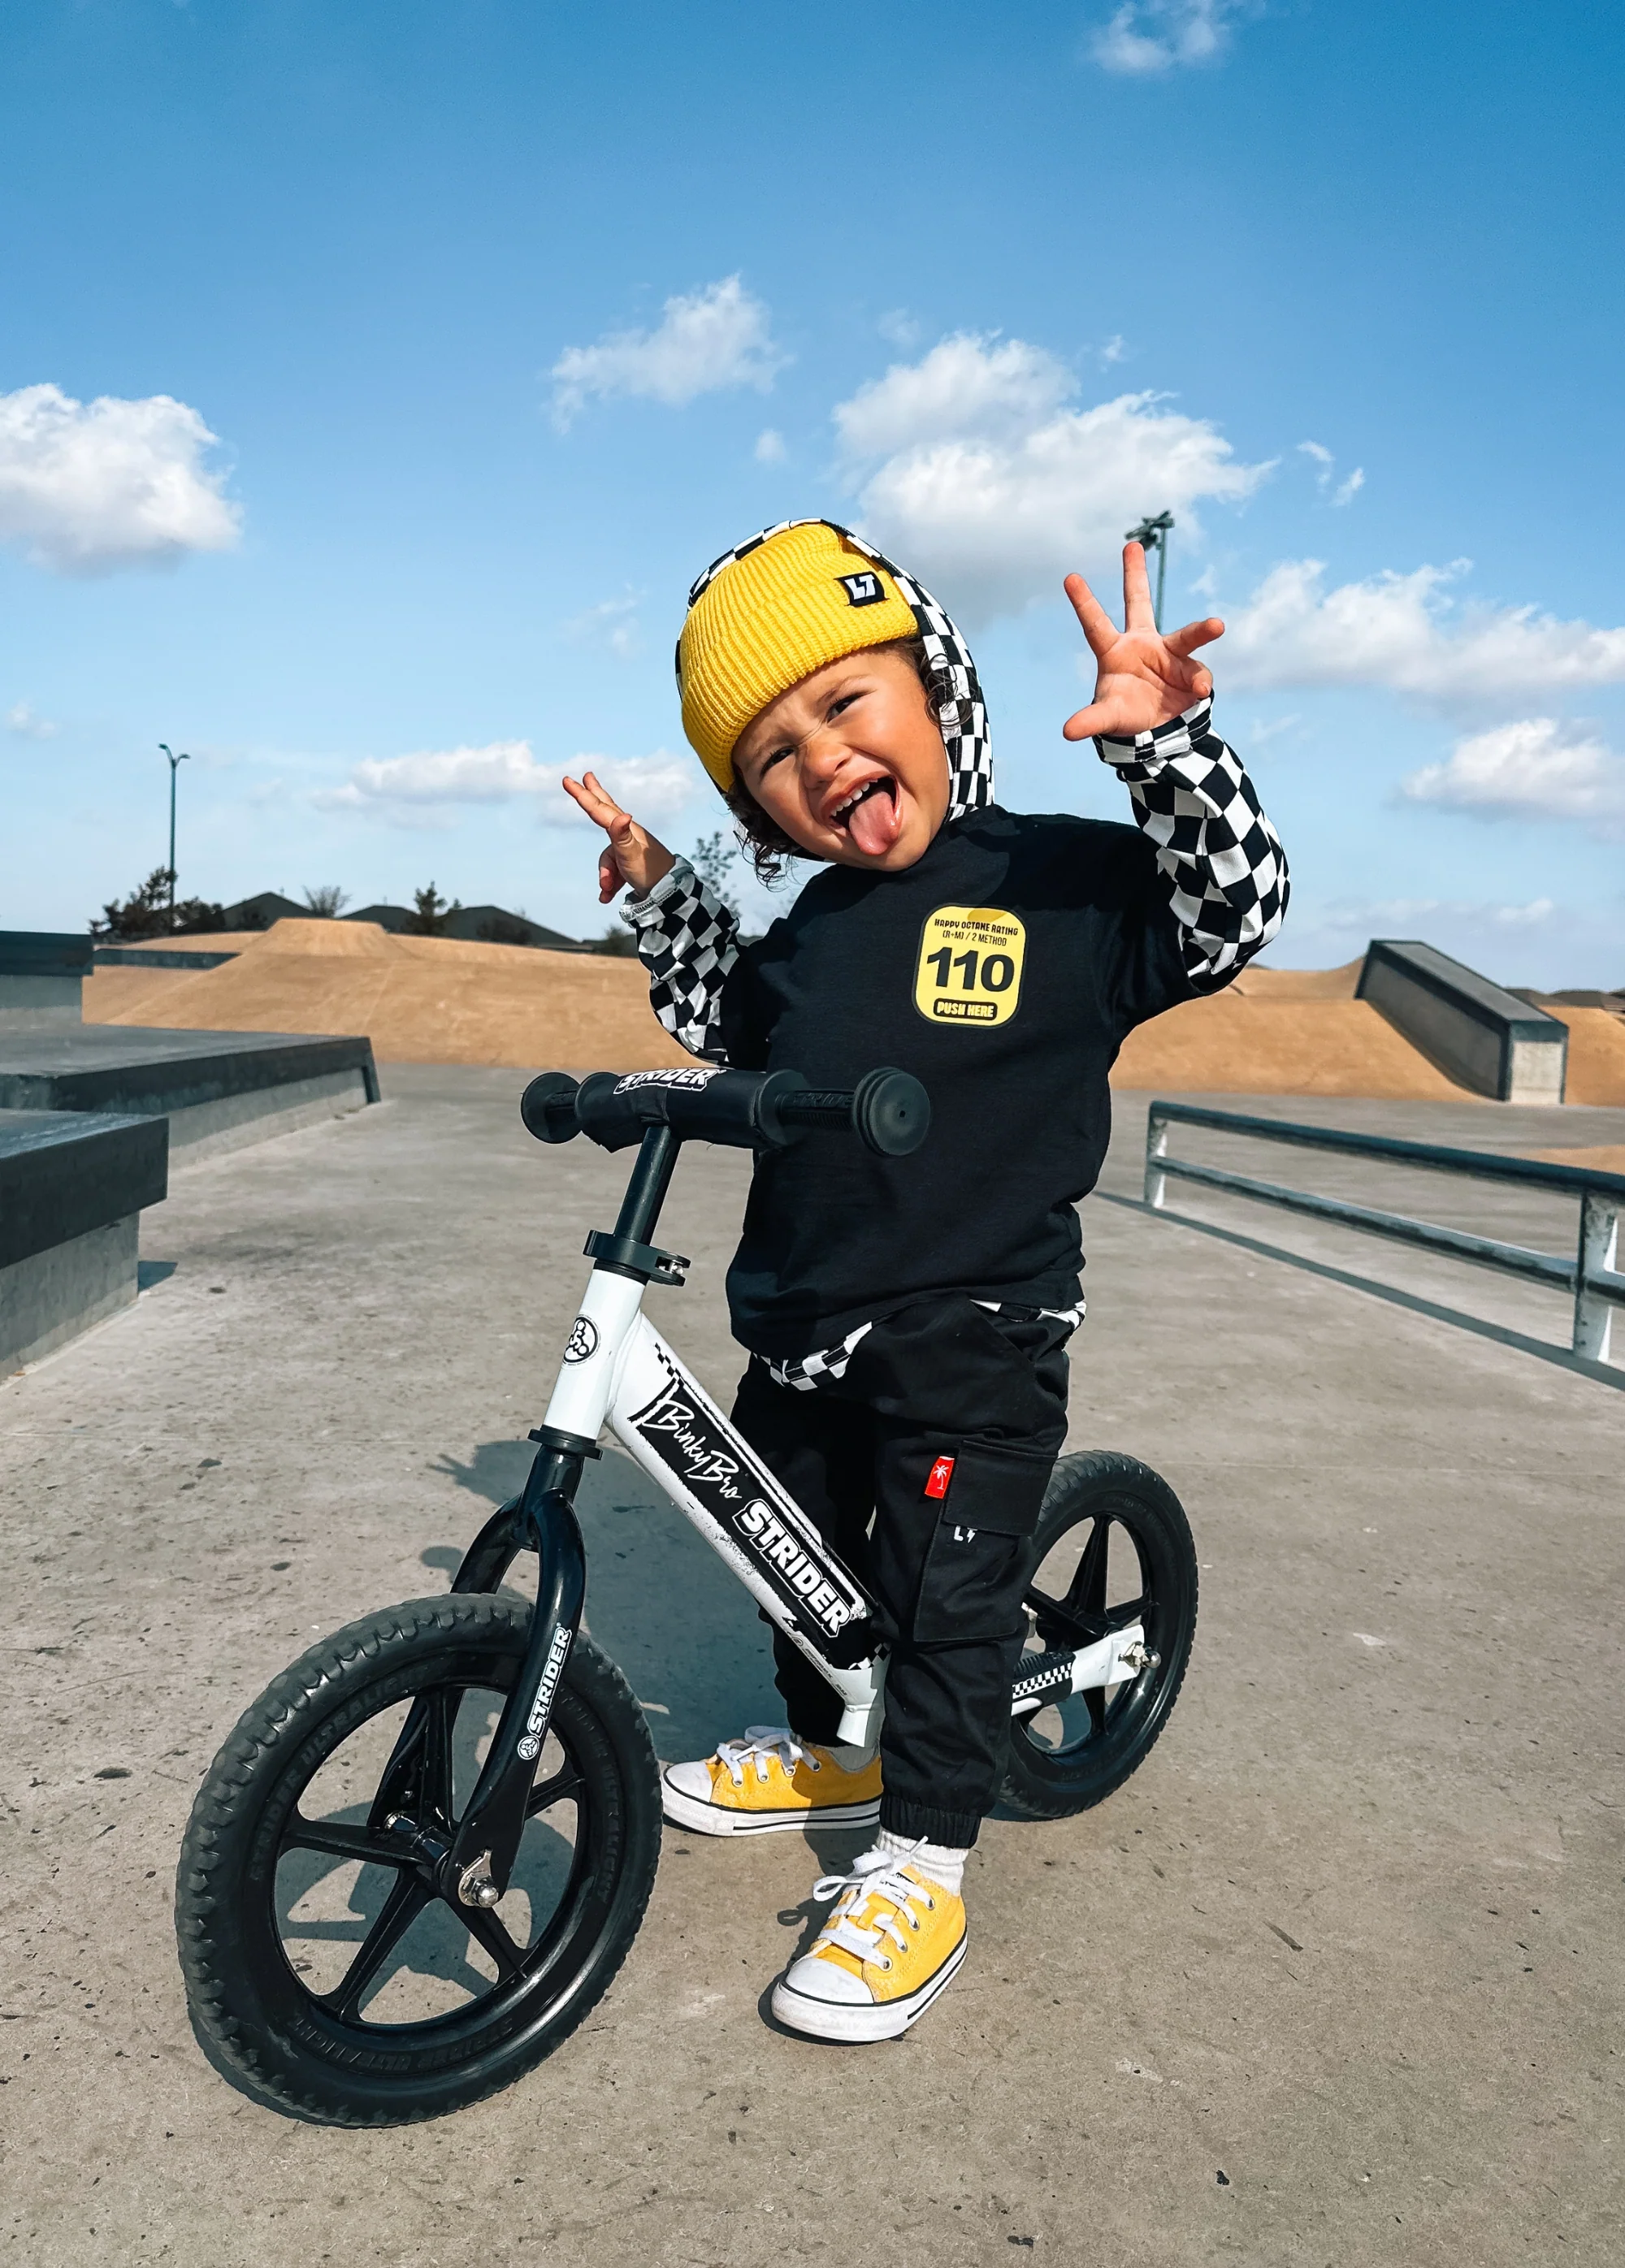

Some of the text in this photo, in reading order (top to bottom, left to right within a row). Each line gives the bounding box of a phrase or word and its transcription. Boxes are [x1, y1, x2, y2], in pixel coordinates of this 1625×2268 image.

[934, 919, 1018, 936] HAPPY OCTANE RATING
[972, 933, 977, 941] 2
[978, 934, 1007, 946] METHOD
[926, 946, 1015, 992] 110
[937, 1002, 994, 1018] PUSH HERE
[614, 1067, 717, 1093] STRIDER
[734, 1500, 852, 1636] STRIDER
[528, 1628, 571, 1737] STRIDER
